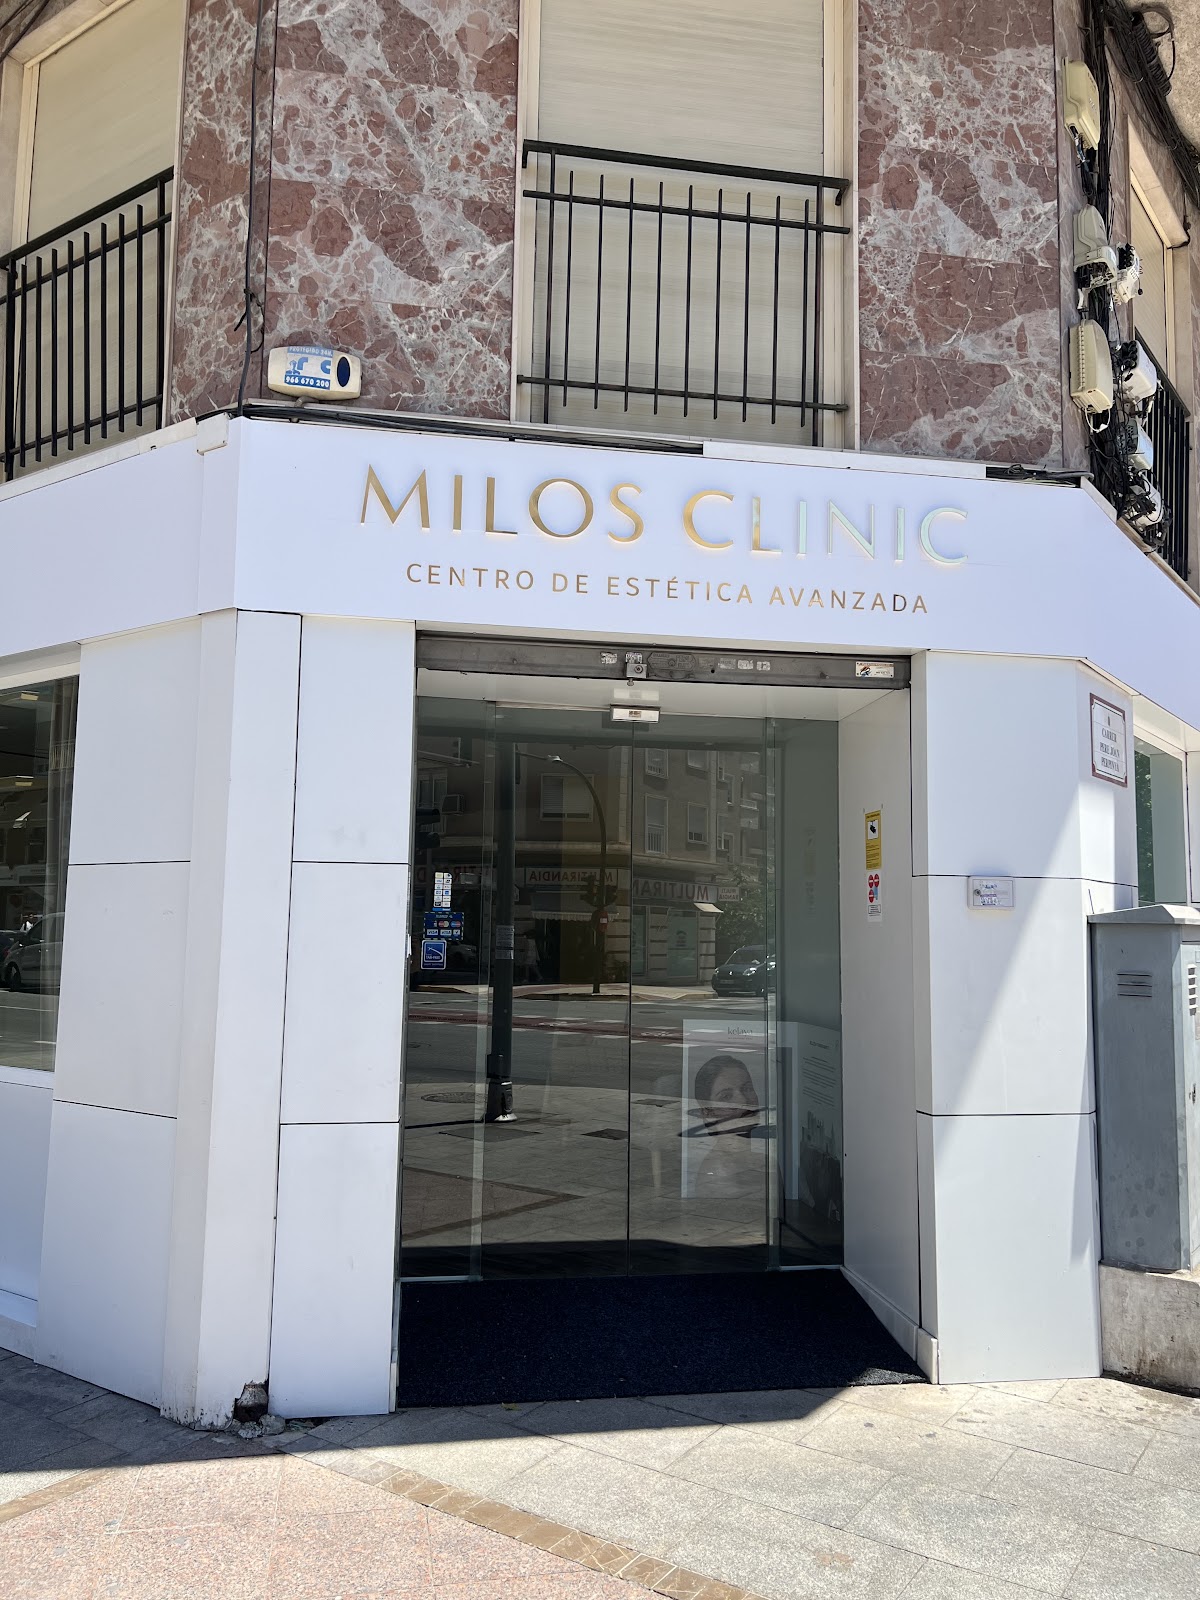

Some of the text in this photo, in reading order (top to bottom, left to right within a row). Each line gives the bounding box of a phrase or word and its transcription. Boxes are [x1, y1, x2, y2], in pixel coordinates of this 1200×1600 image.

[285, 376, 330, 388] 966 670 200
[360, 464, 968, 564] MILOS CLINIC
[406, 563, 928, 613] CENTRO DE ESTÉTICA AVANZADA
[1101, 727, 1117, 743] CARRER
